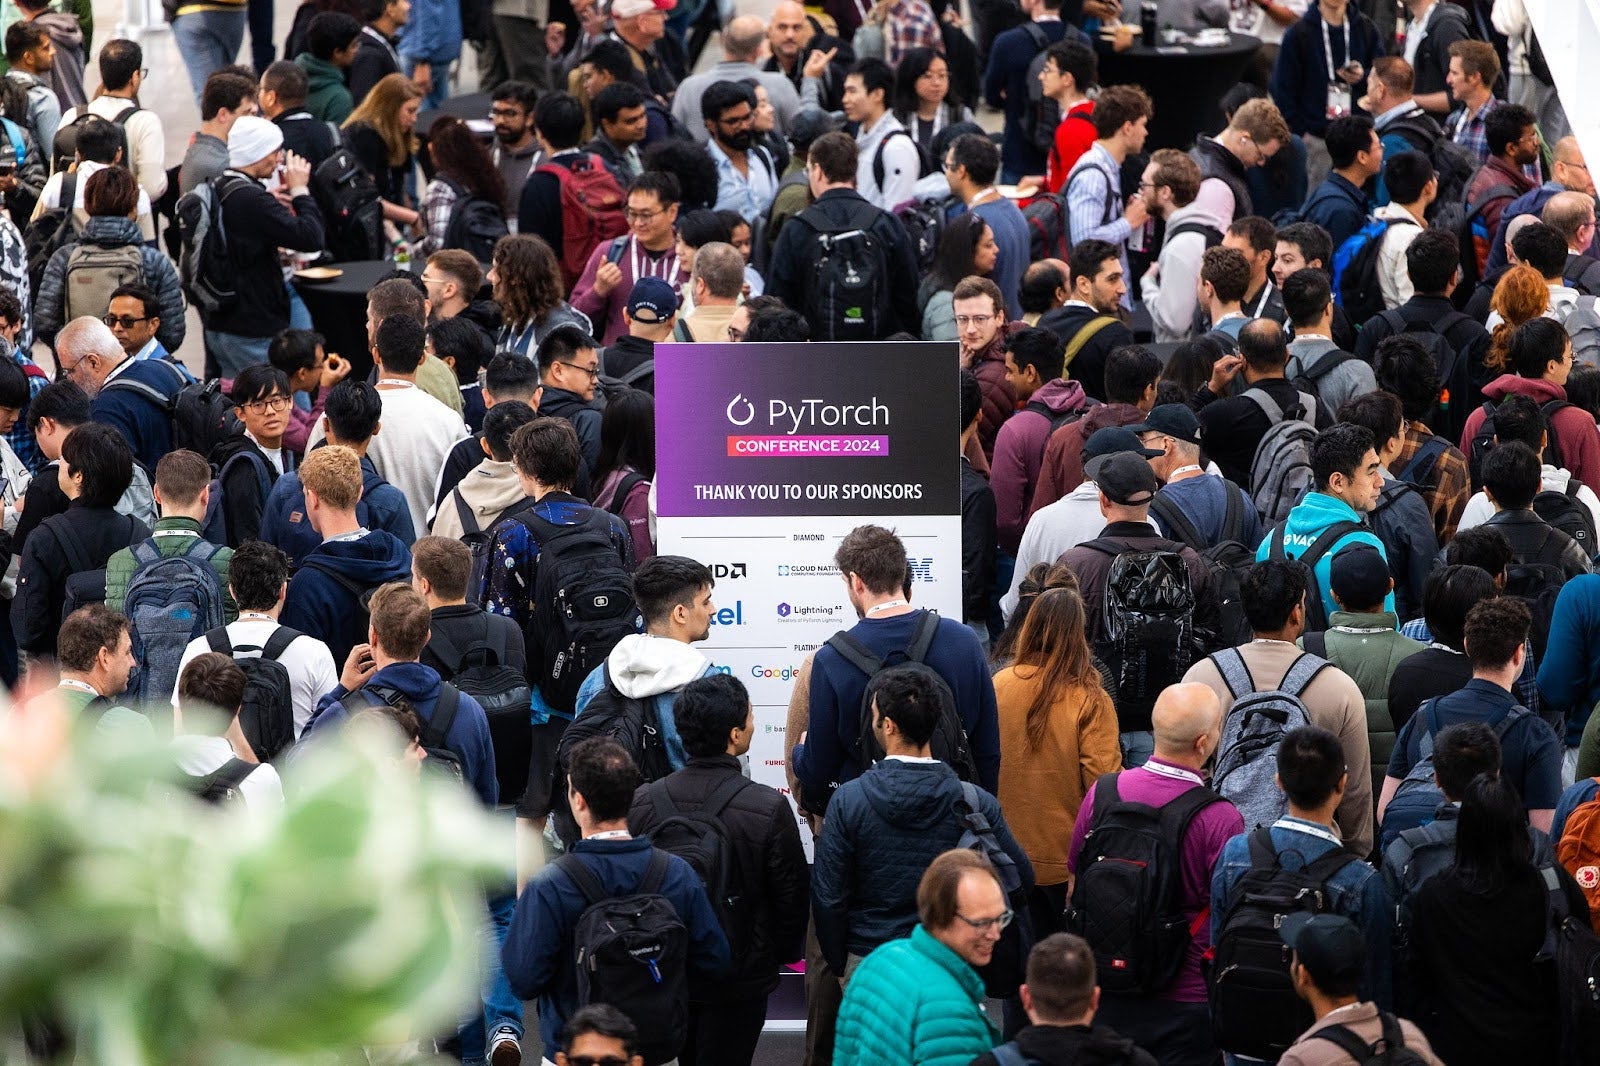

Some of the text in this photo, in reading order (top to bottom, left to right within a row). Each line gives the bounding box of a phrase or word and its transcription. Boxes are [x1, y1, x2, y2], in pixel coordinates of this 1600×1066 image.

[769, 397, 889, 435] PyTorch
[736, 440, 880, 452] CONFERENCE 2024
[694, 483, 923, 500] THANK YOU TO OUR SPONSORS
[794, 606, 833, 616] Lightning
[752, 665, 800, 682] Google
